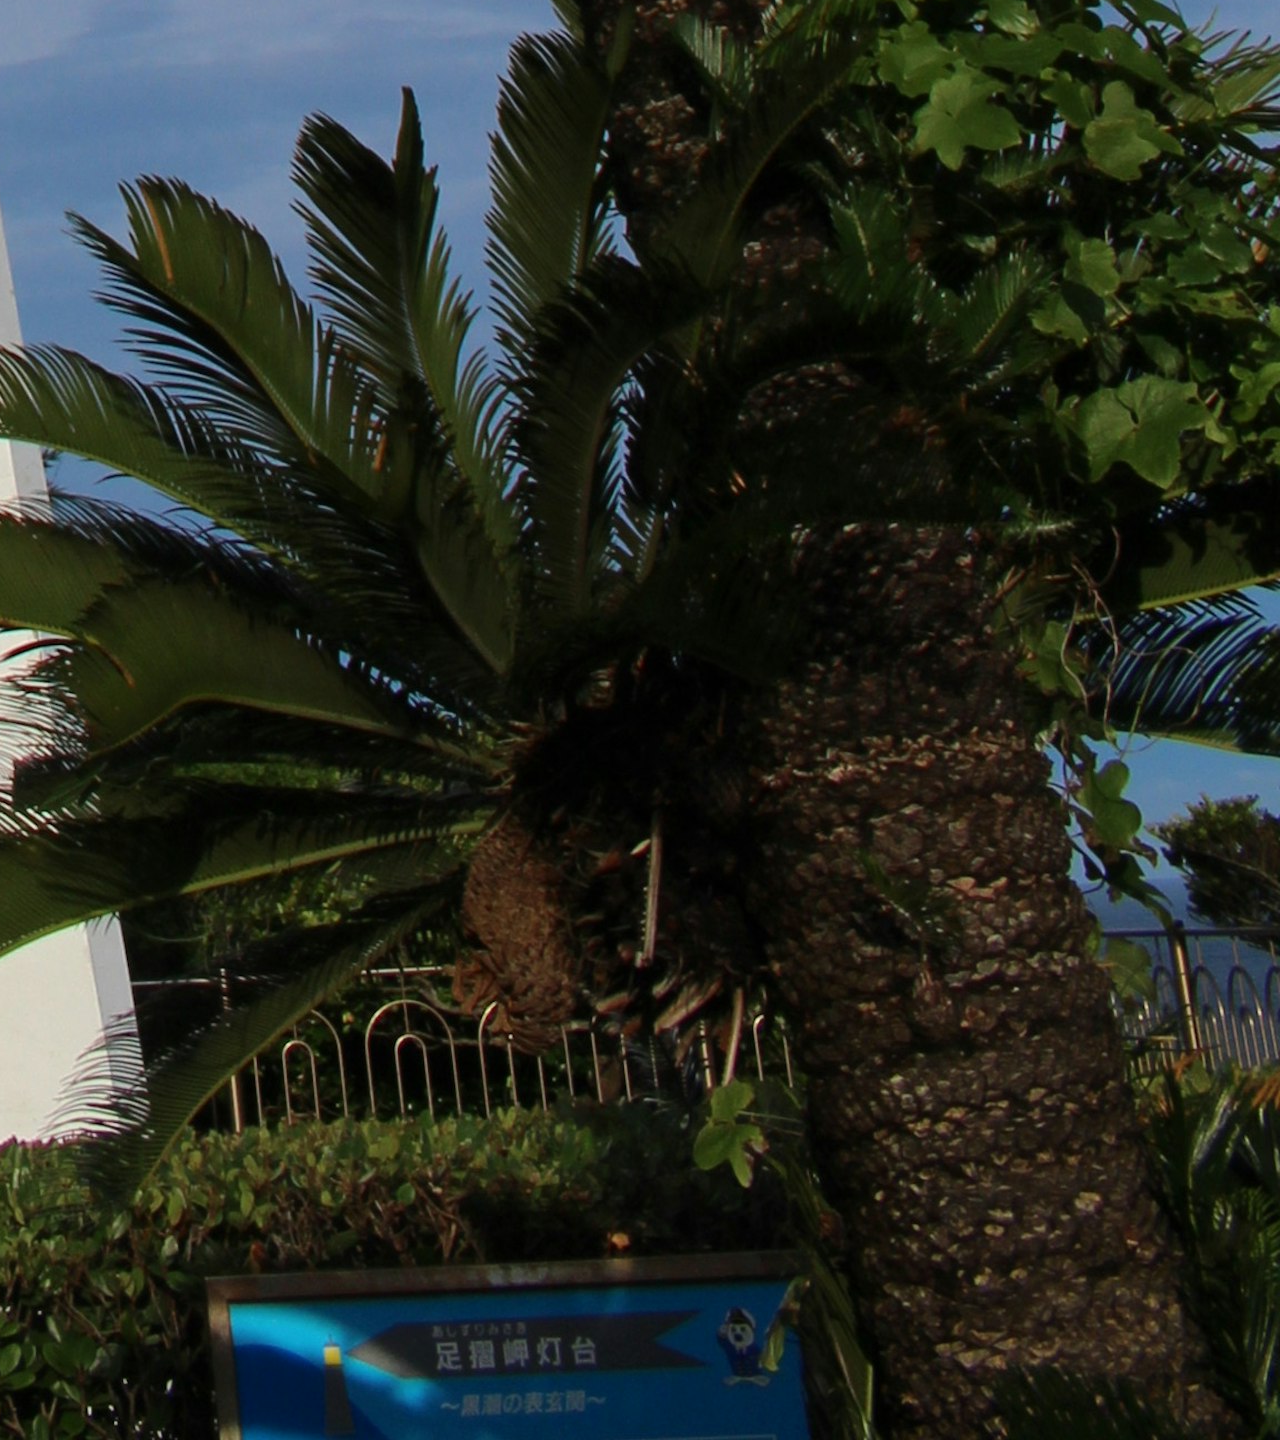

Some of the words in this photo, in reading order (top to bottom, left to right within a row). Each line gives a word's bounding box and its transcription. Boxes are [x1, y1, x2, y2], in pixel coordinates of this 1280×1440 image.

[436, 1336, 597, 1370] 足摺岬灯台
